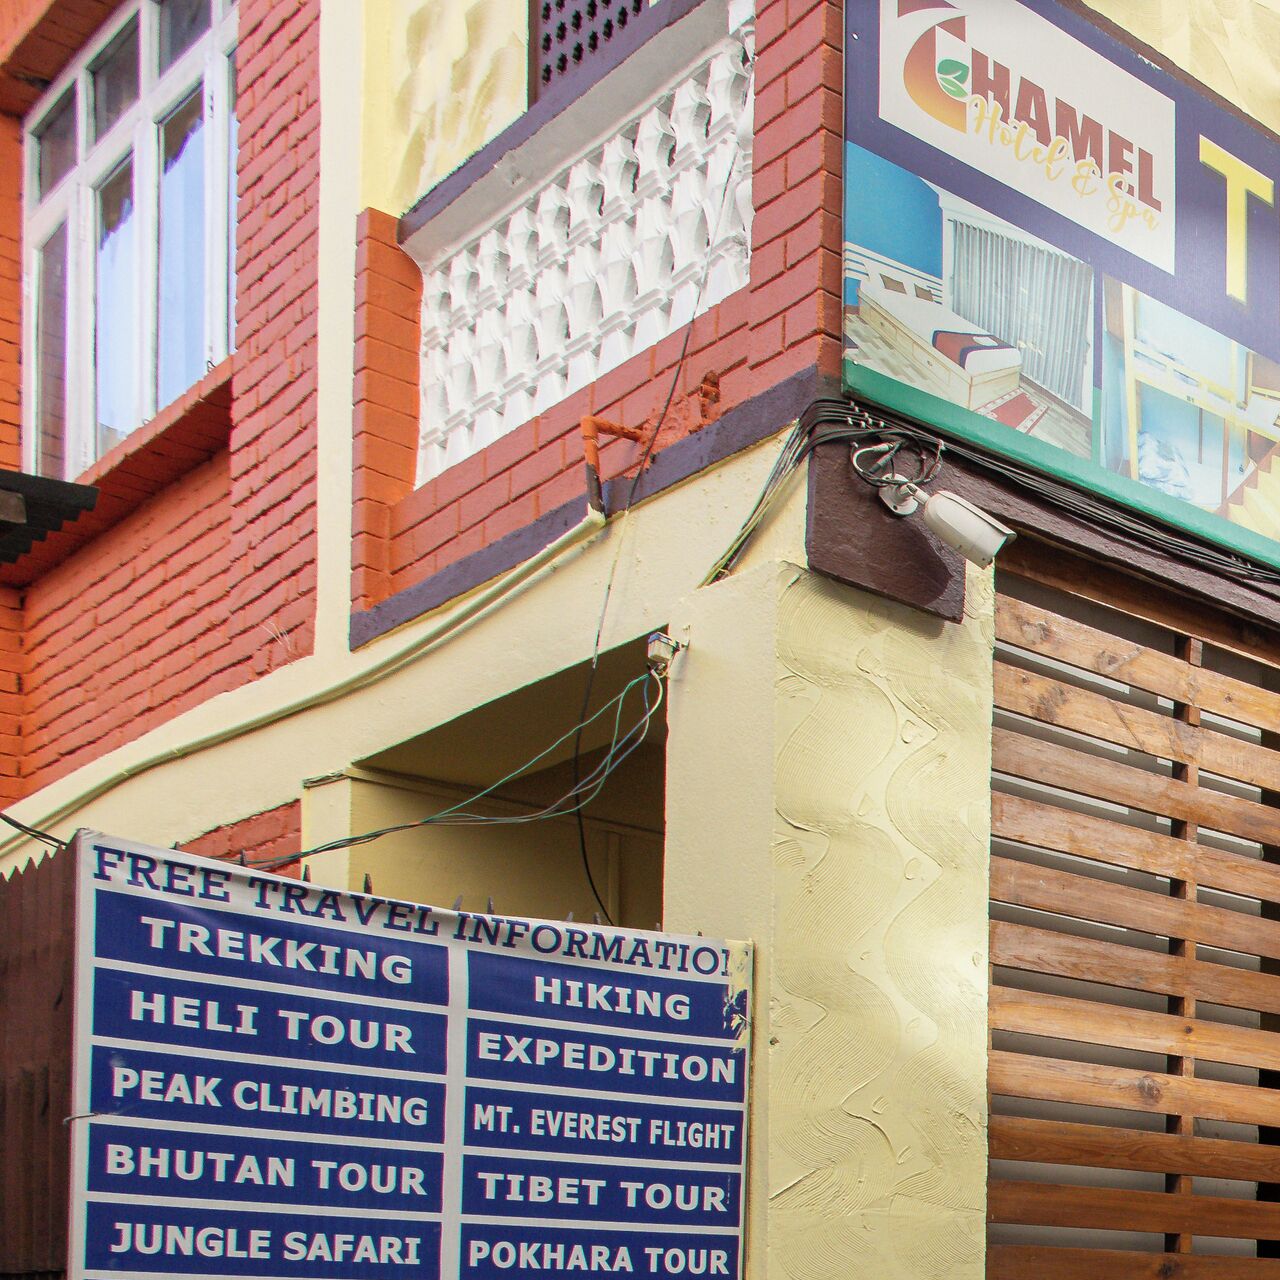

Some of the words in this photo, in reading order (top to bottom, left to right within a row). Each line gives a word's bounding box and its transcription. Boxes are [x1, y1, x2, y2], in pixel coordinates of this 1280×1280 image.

[968, 94, 1069, 181] Hotel
[1071, 156, 1101, 197] &
[1106, 171, 1160, 233] Spa
[92, 848, 231, 904] FREE
[248, 875, 440, 936] TRAVEL
[453, 916, 732, 977] INFORMATIO
[141, 916, 412, 984] TREKKING
[130, 990, 258, 1035] HELI
[278, 1010, 415, 1054] TOUR
[535, 976, 690, 1020] HIKING
[478, 1032, 736, 1083] EXPEDITION
[112, 1066, 222, 1107] PEAK
[233, 1081, 428, 1126] CLIMBING
[473, 1104, 521, 1136] MT.
[530, 1109, 642, 1143] EVEREST
[649, 1120, 735, 1150] FLIGHT
[106, 1144, 294, 1187] BHUTAN
[311, 1160, 427, 1195] TOUR
[478, 1172, 606, 1206] TIBET
[620, 1181, 728, 1212] TOUR
[110, 1222, 271, 1259] JUNGLE
[283, 1232, 420, 1265] SAFARI
[468, 1240, 634, 1272] POKHARA
[644, 1247, 729, 1275] TOUR
